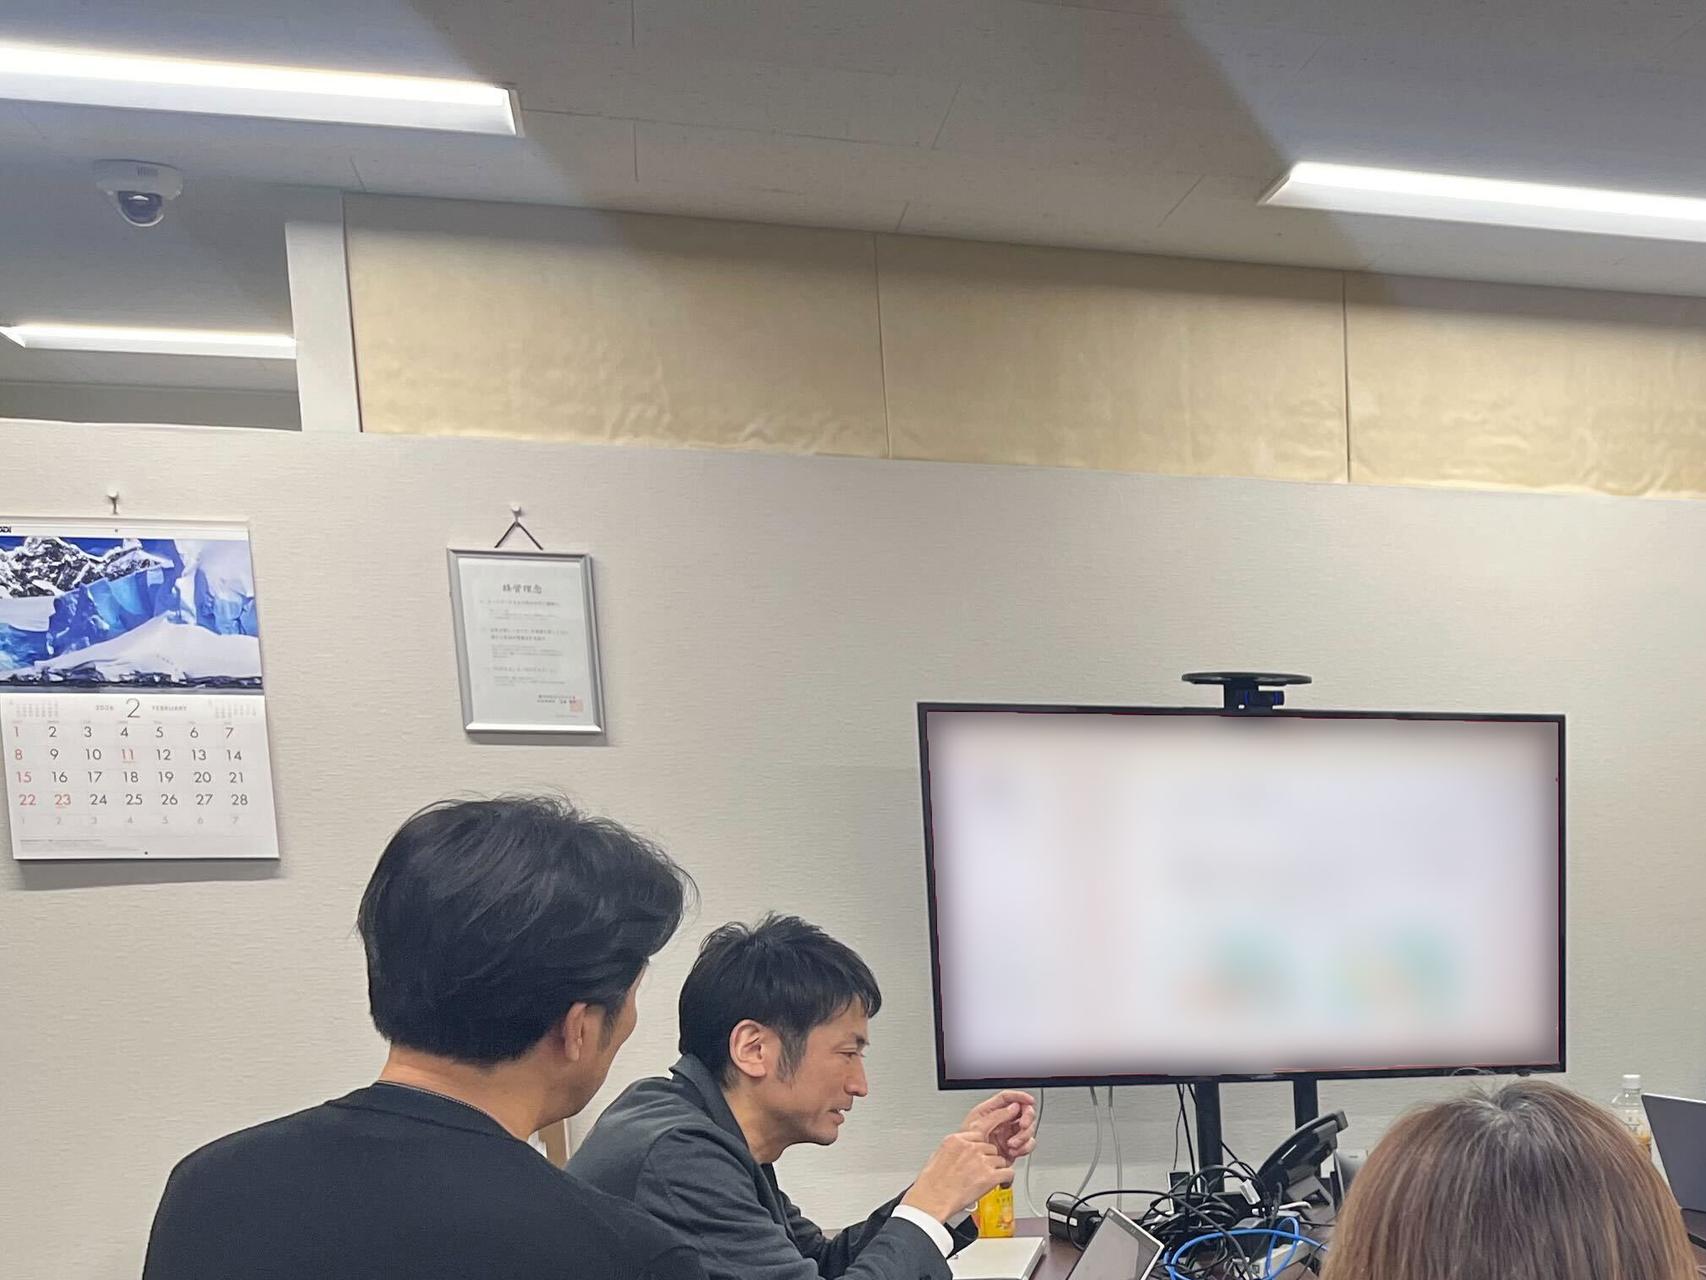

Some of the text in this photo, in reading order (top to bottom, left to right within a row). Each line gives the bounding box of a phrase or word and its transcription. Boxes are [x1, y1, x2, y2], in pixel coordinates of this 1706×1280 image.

[126, 697, 141, 719] 2
[13, 726, 234, 739] 1 2 3 4 5 6 7
[14, 749, 242, 761] 8 9 10 11 12 13 14
[16, 771, 244, 784] 15 16 17 18 19 20 21
[18, 794, 249, 806] 22 23 24 25 26 27 28
